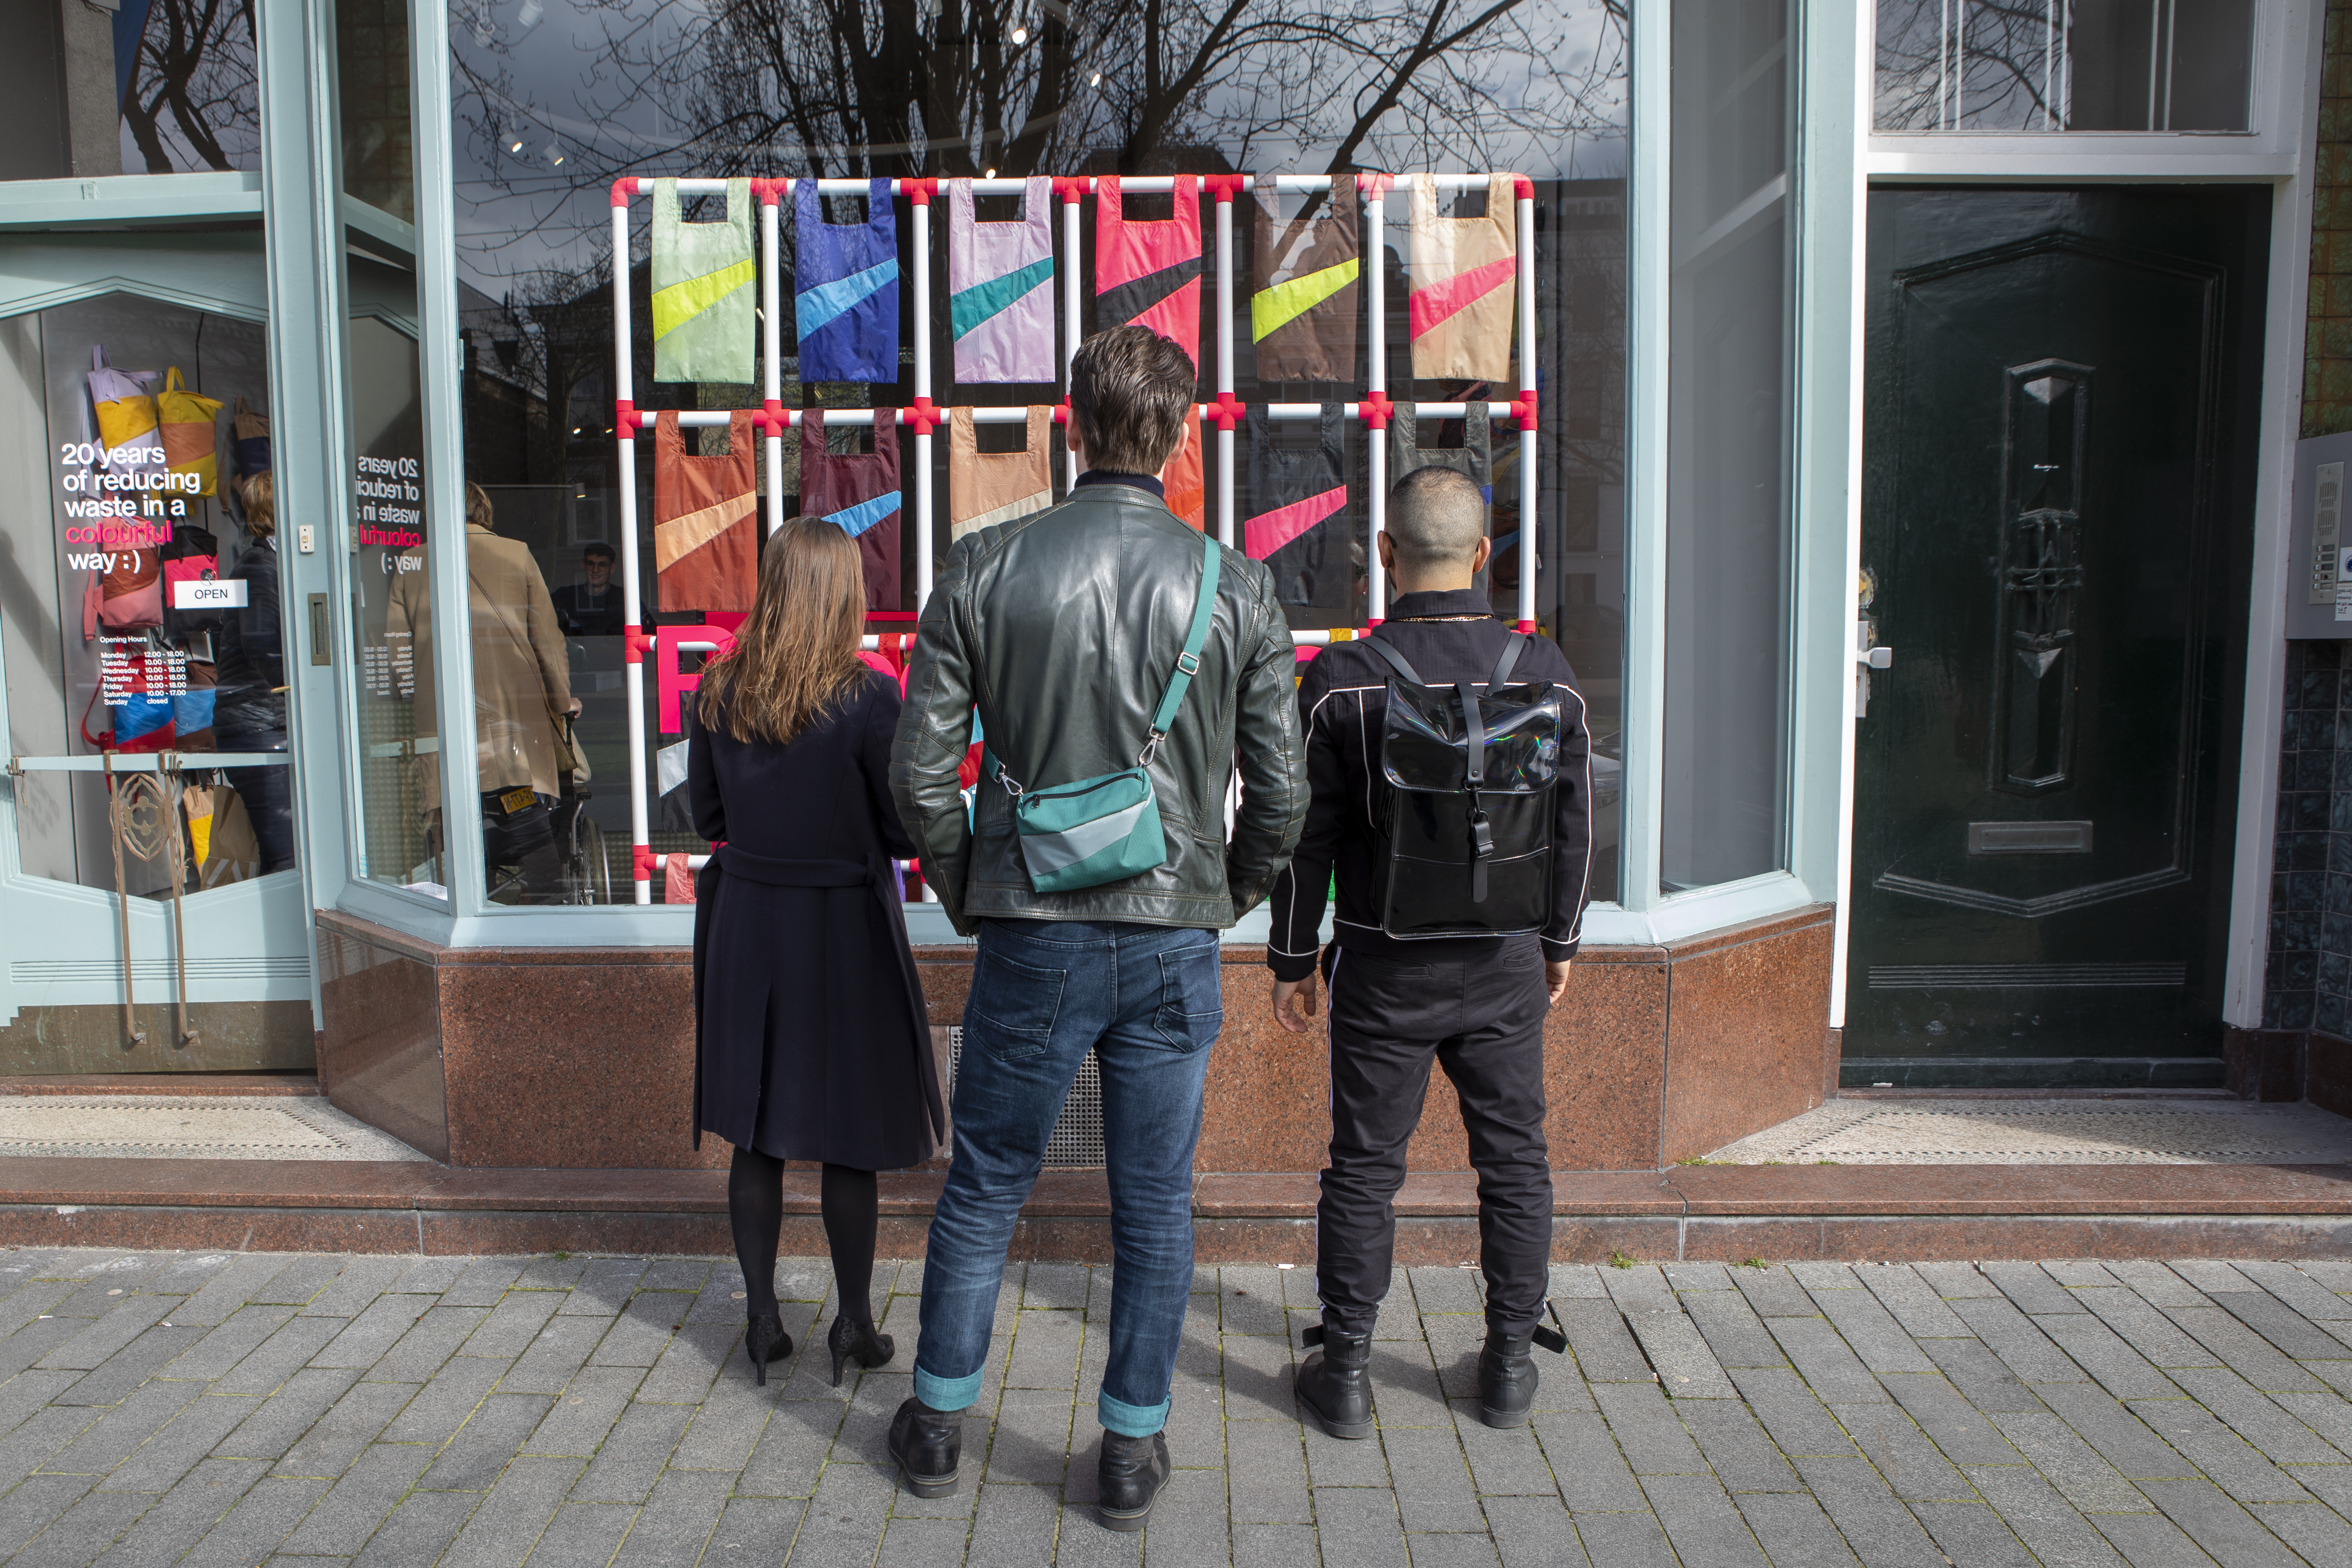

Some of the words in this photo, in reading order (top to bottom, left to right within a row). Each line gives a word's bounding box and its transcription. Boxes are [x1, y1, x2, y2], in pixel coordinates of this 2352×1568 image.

[61, 443, 95, 466] 20
[99, 445, 166, 469] years
[63, 470, 87, 492] of
[94, 468, 201, 494] reducing
[63, 496, 136, 518] waste
[143, 495, 164, 516] in
[170, 499, 186, 516] a
[66, 520, 172, 544] colourful
[67, 552, 116, 575] way
[123, 549, 141, 573] :)
[195, 589, 228, 599] OPEN
